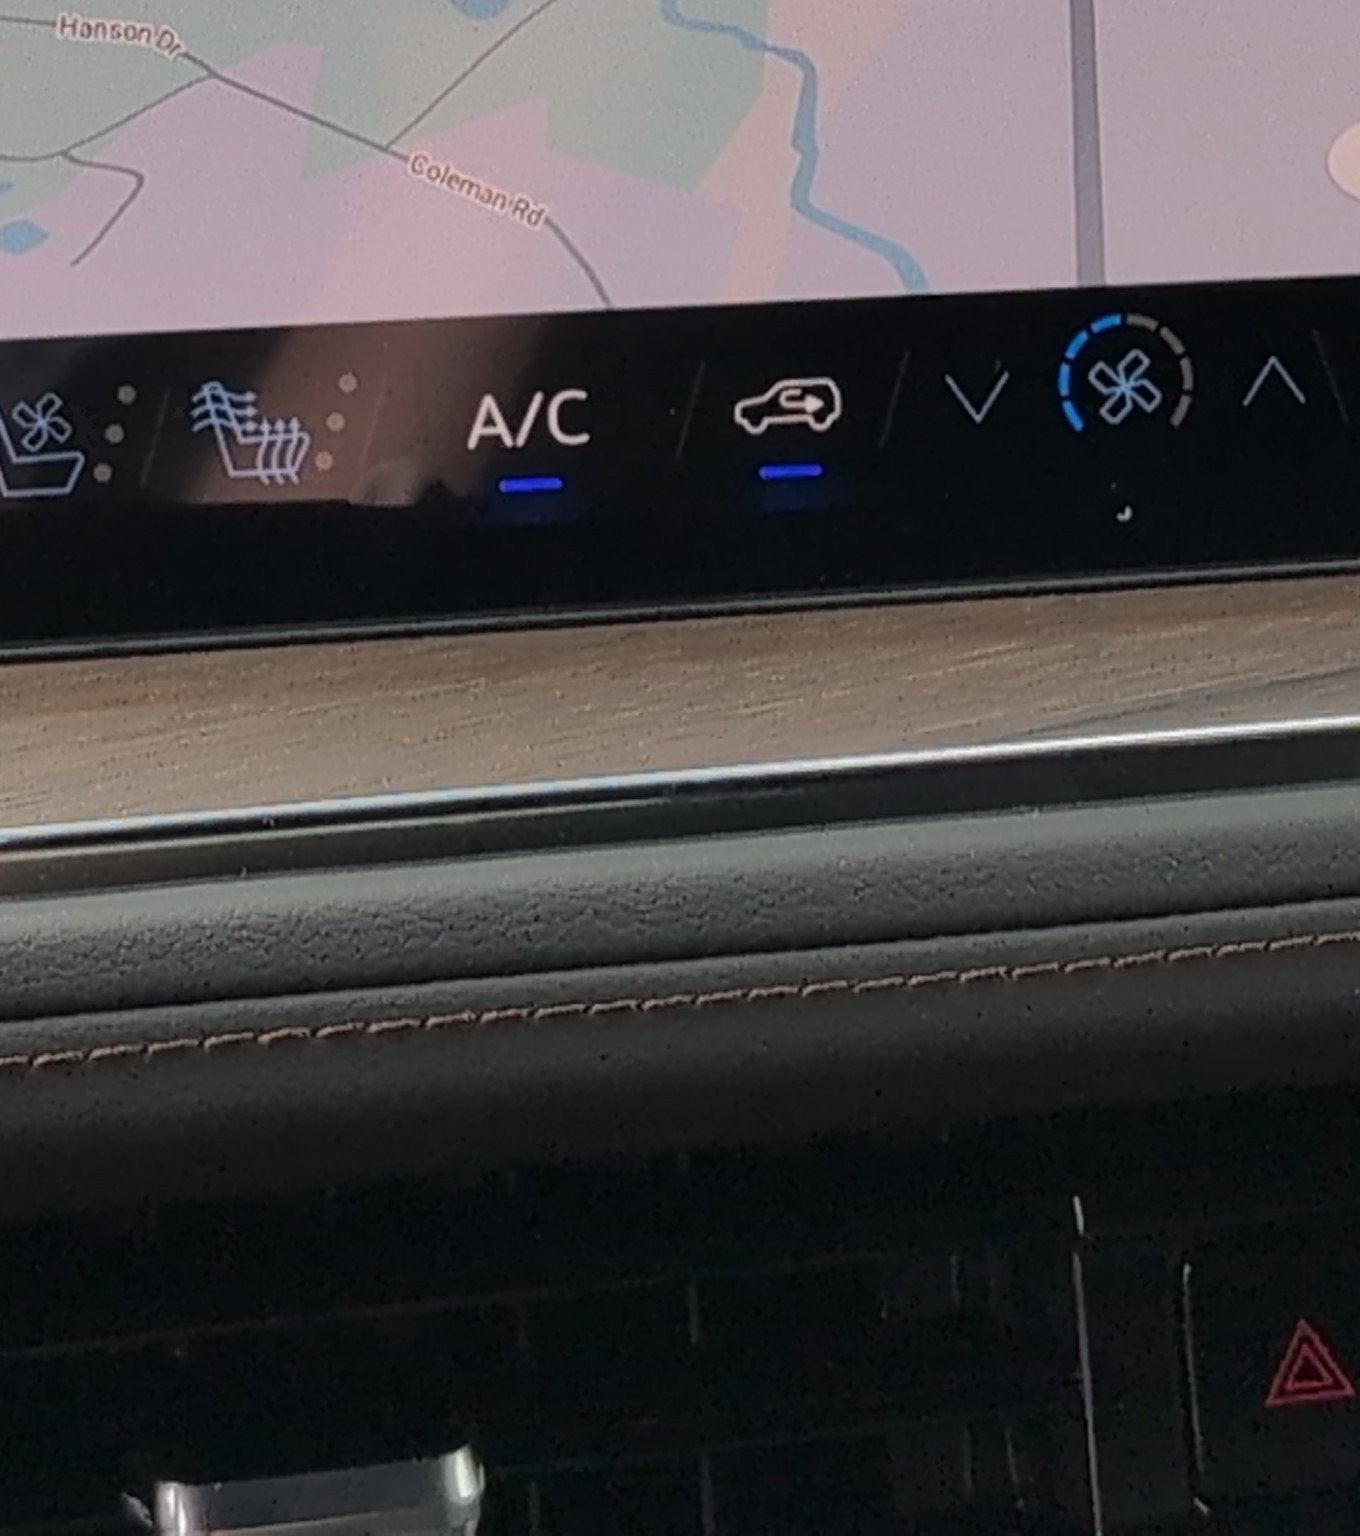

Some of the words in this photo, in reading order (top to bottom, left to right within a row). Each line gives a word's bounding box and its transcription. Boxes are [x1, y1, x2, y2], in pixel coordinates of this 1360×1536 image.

[57, 16, 155, 48] Hanson
[156, 29, 182, 56] Dr
[409, 154, 509, 214] Coleman
[509, 199, 545, 227] Rd
[467, 390, 591, 450] A/C
